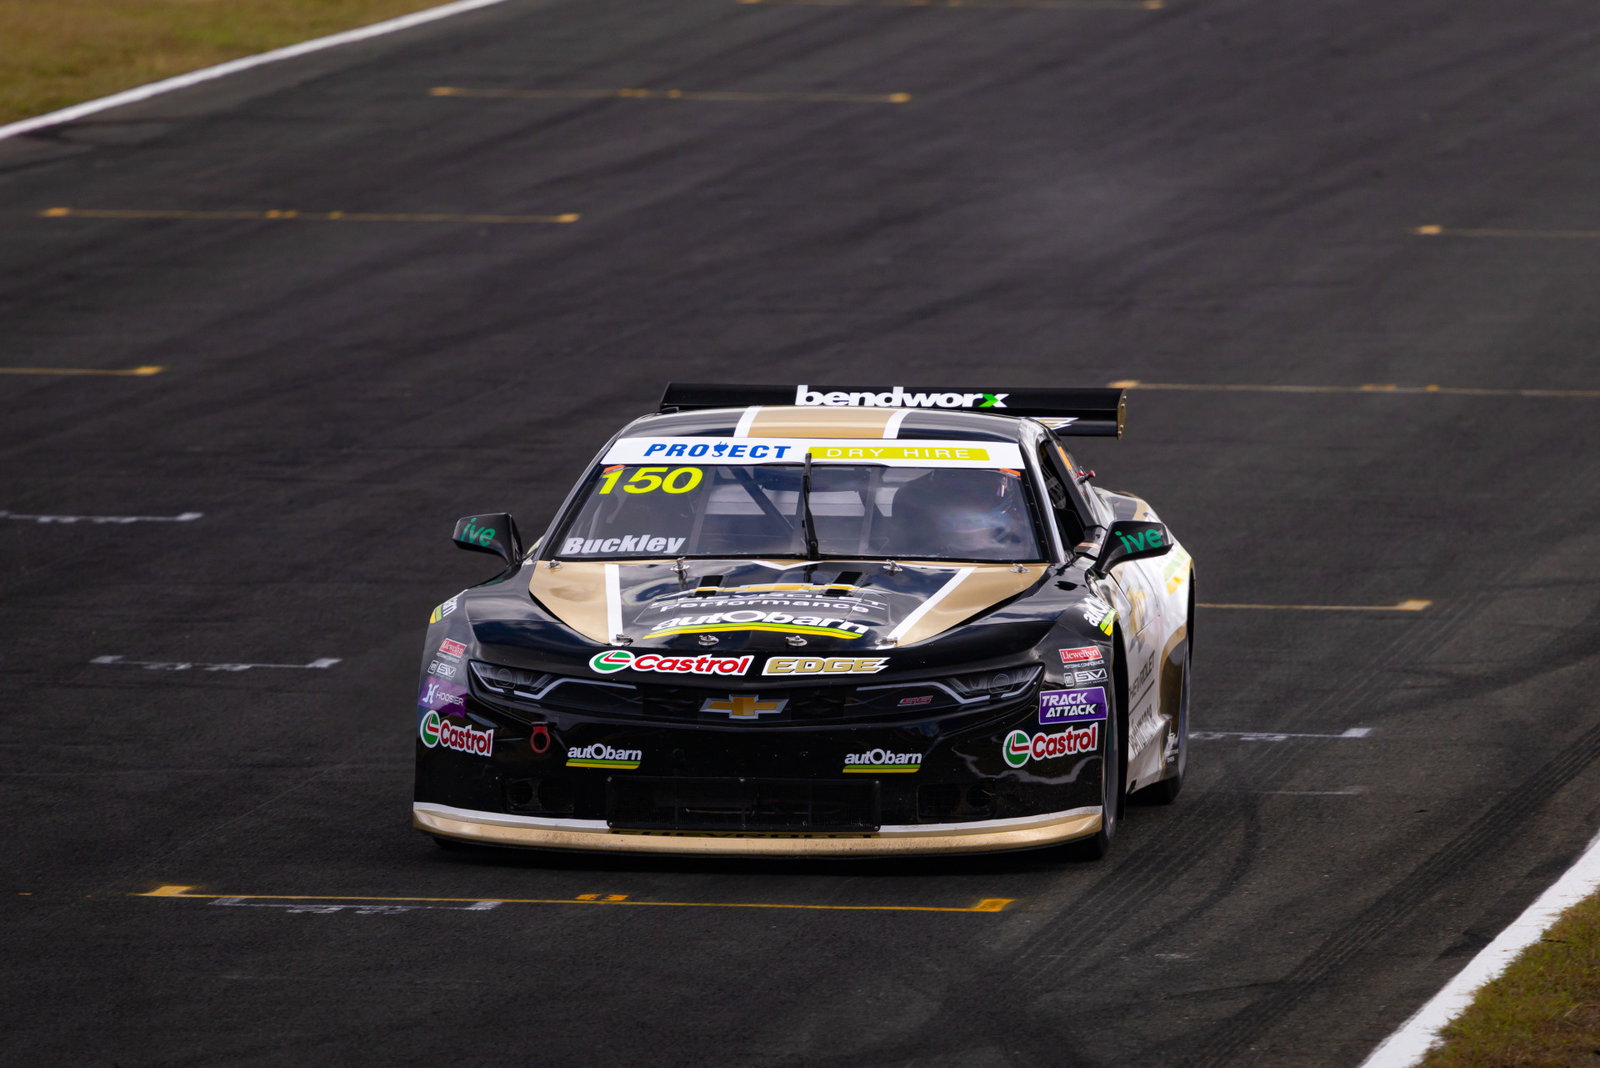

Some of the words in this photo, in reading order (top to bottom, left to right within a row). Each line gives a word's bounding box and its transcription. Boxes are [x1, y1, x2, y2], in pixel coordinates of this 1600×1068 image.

[795, 385, 1009, 408] bendworx
[826, 448, 884, 458] DRY
[903, 448, 971, 459] HIRE
[599, 467, 703, 494] 150
[460, 518, 496, 546] ive
[1115, 528, 1164, 554] ive
[560, 535, 686, 555] Buckley
[660, 598, 870, 613] Performance
[634, 655, 750, 673] Castrol
[766, 658, 886, 673] EDGE
[1061, 650, 1100, 660] Llewellyn
[1042, 692, 1087, 706] TRACK
[1046, 703, 1097, 718] ATTACK
[440, 720, 492, 755] Castrol
[1032, 725, 1096, 758] Castrol
